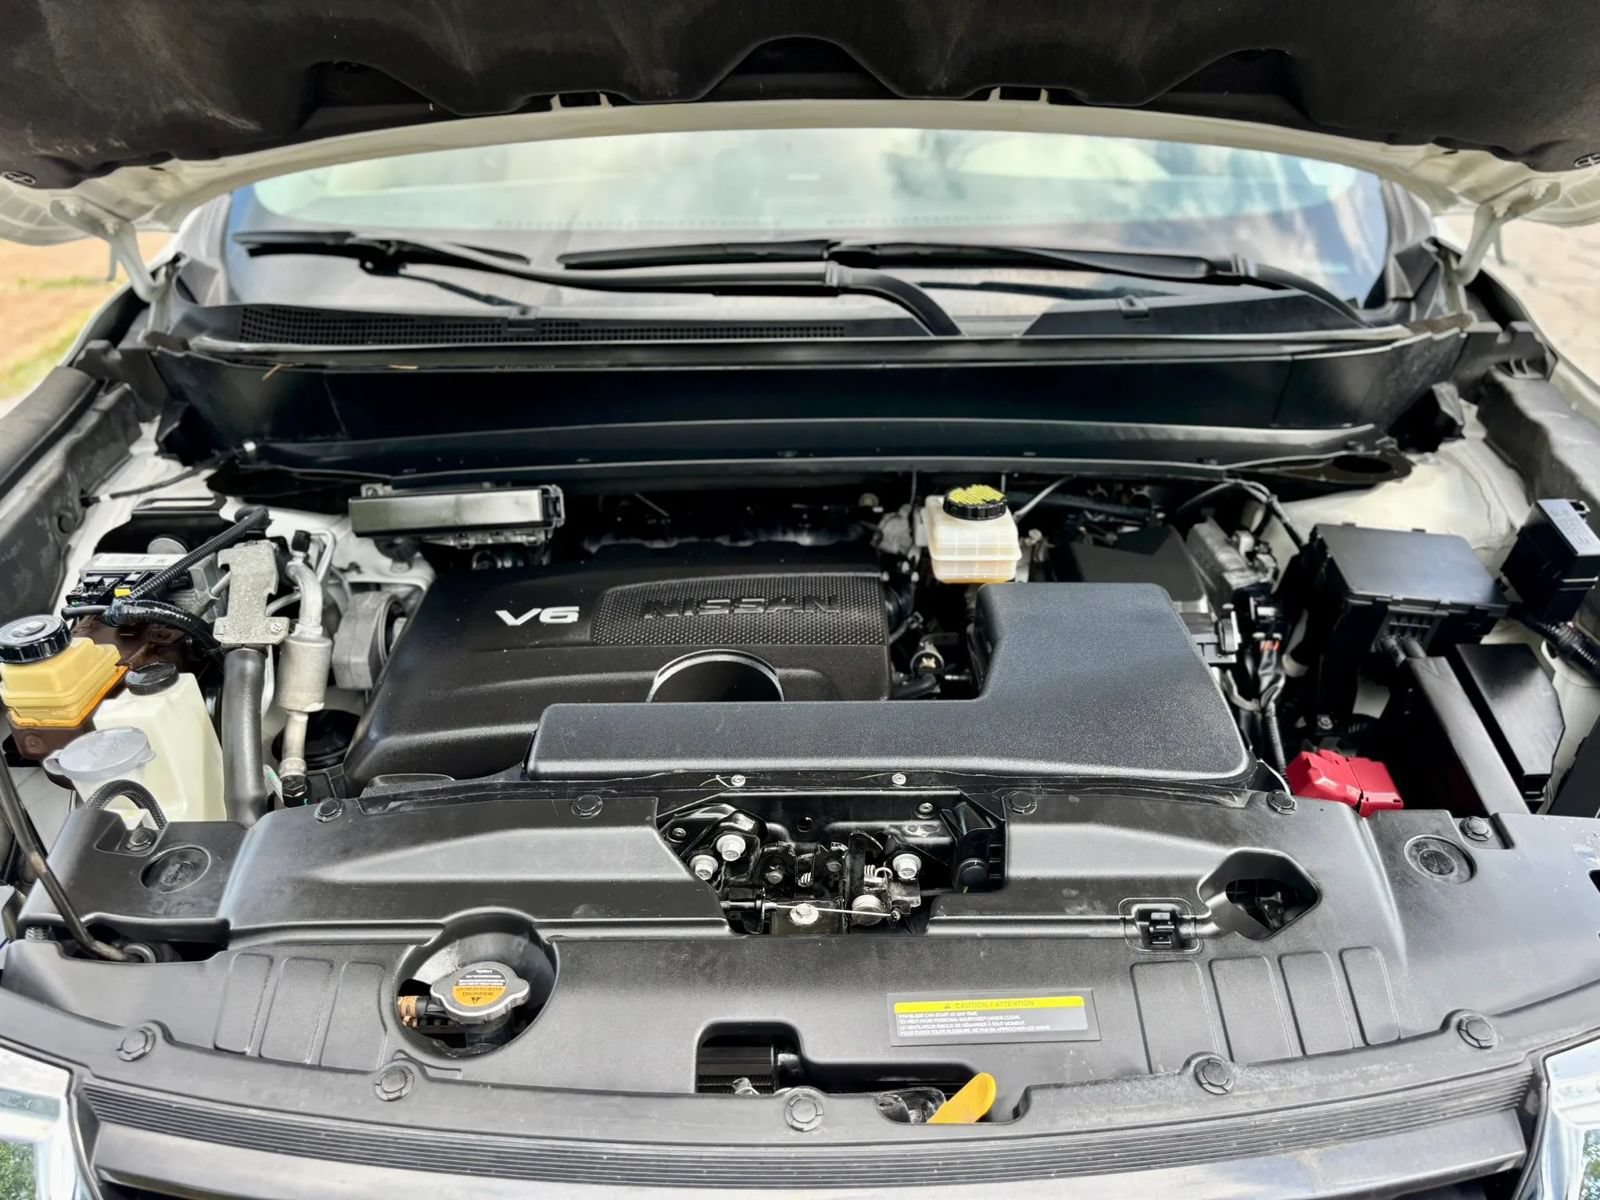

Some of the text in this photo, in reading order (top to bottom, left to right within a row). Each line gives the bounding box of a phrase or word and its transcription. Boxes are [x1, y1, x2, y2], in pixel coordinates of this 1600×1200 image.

[495, 606, 580, 626] V6
[645, 596, 841, 619] NISSAN
[994, 1000, 1034, 1008] ATTENTION
